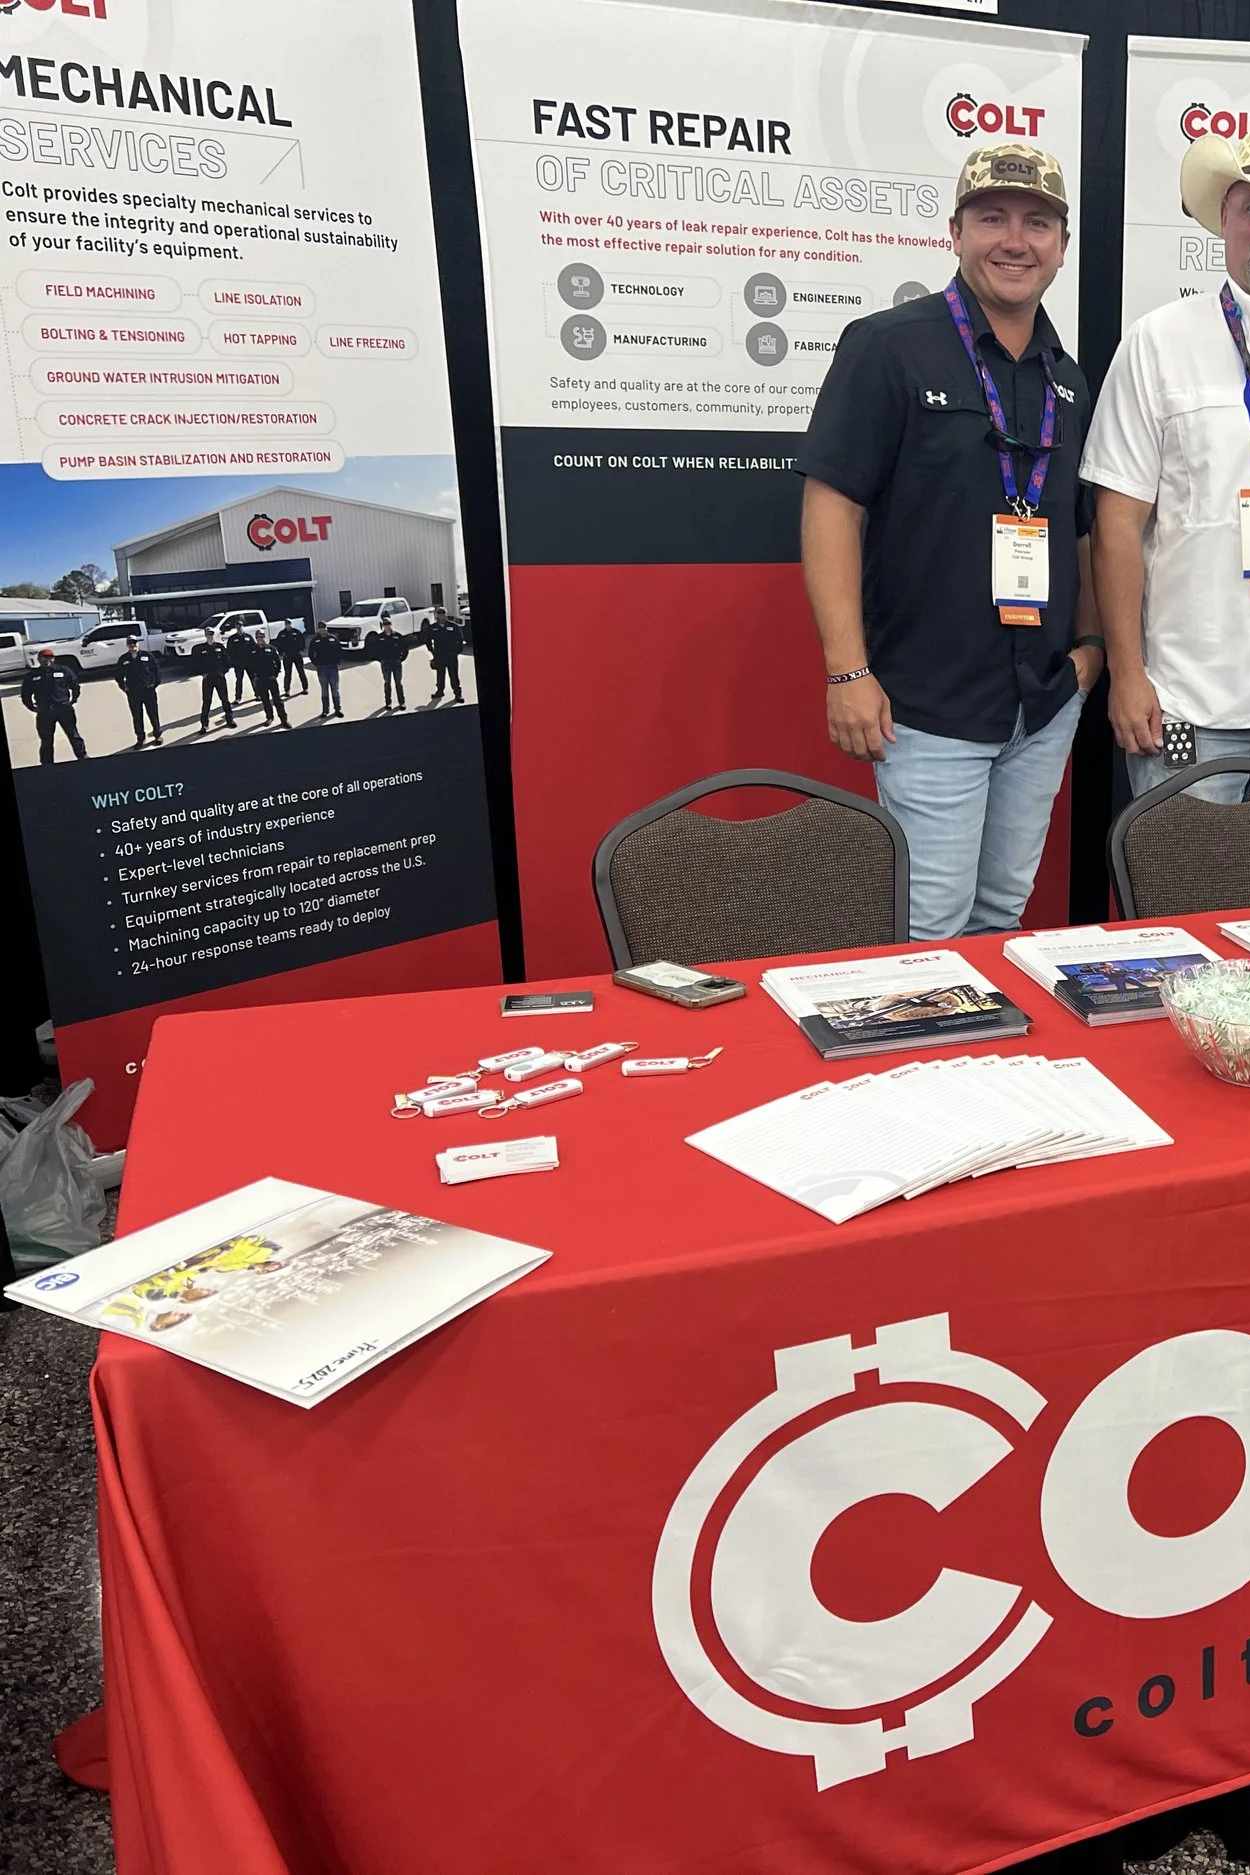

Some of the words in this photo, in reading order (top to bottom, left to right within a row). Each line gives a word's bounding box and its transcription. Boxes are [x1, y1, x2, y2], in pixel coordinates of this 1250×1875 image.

[0, 56, 292, 128] MECHANICAL
[532, 99, 637, 142] FAST
[649, 109, 791, 155] REPAIR
[947, 94, 1046, 137] COLT
[0, 118, 228, 180] SERVICES
[994, 160, 1035, 176] COLT
[535, 154, 591, 193] OF
[600, 159, 785, 207] CRITICAL
[792, 174, 939, 219] ASSETS
[1, 180, 38, 199] Colt
[43, 186, 118, 204] provides
[122, 192, 196, 214] specialty
[201, 199, 290, 218] mechanical
[293, 207, 355, 224] services
[357, 211, 372, 225] to
[5, 209, 67, 225] ensure
[71, 211, 100, 227] the
[104, 212, 175, 236] integrity
[179, 220, 209, 234] and
[213, 224, 300, 241] operational
[304, 231, 398, 252] sustainability
[539, 210, 570, 224] With
[574, 215, 603, 226] over
[606, 215, 623, 228] 40
[626, 219, 662, 231] years
[665, 219, 678, 231] of
[681, 219, 708, 232] leak
[711, 223, 748, 237] repair
[751, 226, 821, 240] experience,
[825, 229, 849, 241] Colt
[851, 231, 872, 243] has
[875, 232, 895, 245] the
[540, 233, 563, 246] the
[566, 237, 600, 248] most
[603, 237, 662, 252] effective
[665, 241, 703, 255] repair
[705, 243, 755, 257] solution
[758, 246, 776, 258] for
[779, 249, 800, 262] any
[803, 249, 862, 263] condition.
[45, 284, 83, 297] FIELD
[85, 286, 155, 300] MACHINING
[214, 292, 241, 304] LINE
[243, 293, 302, 306] ISOLATION
[610, 283, 684, 297] TECHNOLOGY
[793, 292, 862, 305] ENGINEERING
[40, 327, 95, 340] BOLTING
[99, 329, 108, 341] &
[110, 329, 185, 342] TENSIONING
[223, 333, 246, 344] HOT
[249, 333, 297, 346] TAPPING
[329, 337, 354, 348] LINE
[356, 337, 405, 349] FREEZING
[613, 334, 707, 347] MANUFACTURING
[47, 371, 100, 383] GROUND
[102, 372, 147, 383] WATER
[149, 372, 213, 384] INTRUSION
[215, 373, 280, 385] MITIGATION
[58, 414, 127, 426] CONCRETE
[130, 413, 171, 425] CRACK
[174, 413, 317, 424] INJECTION/RESTORATION
[59, 456, 95, 468] PUMP
[98, 455, 137, 467] BASIN
[139, 453, 226, 466] STABILIZATION
[229, 453, 254, 464] AND
[256, 451, 331, 463] RESTORATION
[553, 454, 603, 467] COUNT
[608, 455, 627, 468] ON
[632, 456, 668, 468] COLT
[672, 456, 714, 469] WHEN
[248, 515, 332, 550] COLT
[91, 790, 130, 809] WHY
[134, 782, 184, 802] COLT?
[111, 816, 157, 833] Safety
[161, 809, 186, 825] and
[190, 803, 234, 822] quality
[237, 799, 258, 812] are
[261, 795, 275, 808] at
[277, 792, 298, 805] the
[301, 788, 329, 801] core
[331, 782, 343, 795] of
[346, 780, 360, 793] all
[362, 772, 423, 792] operations
[115, 842, 142, 856] 40+
[145, 836, 185, 855] years
[188, 830, 202, 844] of
[206, 822, 261, 840] industry
[265, 809, 335, 830] experience
[118, 853, 205, 881] Expert-level
[208, 841, 285, 864] technicians
[121, 885, 177, 904] Turnkey
[181, 873, 239, 893] services
[242, 866, 274, 880] from
[277, 856, 314, 874] repair
[317, 854, 330, 865] to
[333, 838, 407, 862] replacement
[410, 833, 436, 849] prep
[125, 902, 202, 928] Equipment
[205, 884, 286, 911] strategically
[289, 873, 336, 893] located
[339, 867, 379, 883] across
[381, 862, 400, 874] the
[403, 855, 426, 869] U.S.
[131, 953, 188, 975] 24-hour
[191, 938, 253, 961] response
[256, 928, 297, 946] teams
[299, 919, 334, 936] ready
[336, 916, 349, 927] to
[352, 907, 391, 923] deploy
[899, 955, 942, 965] COLT
[452, 1150, 501, 1164] COLT
